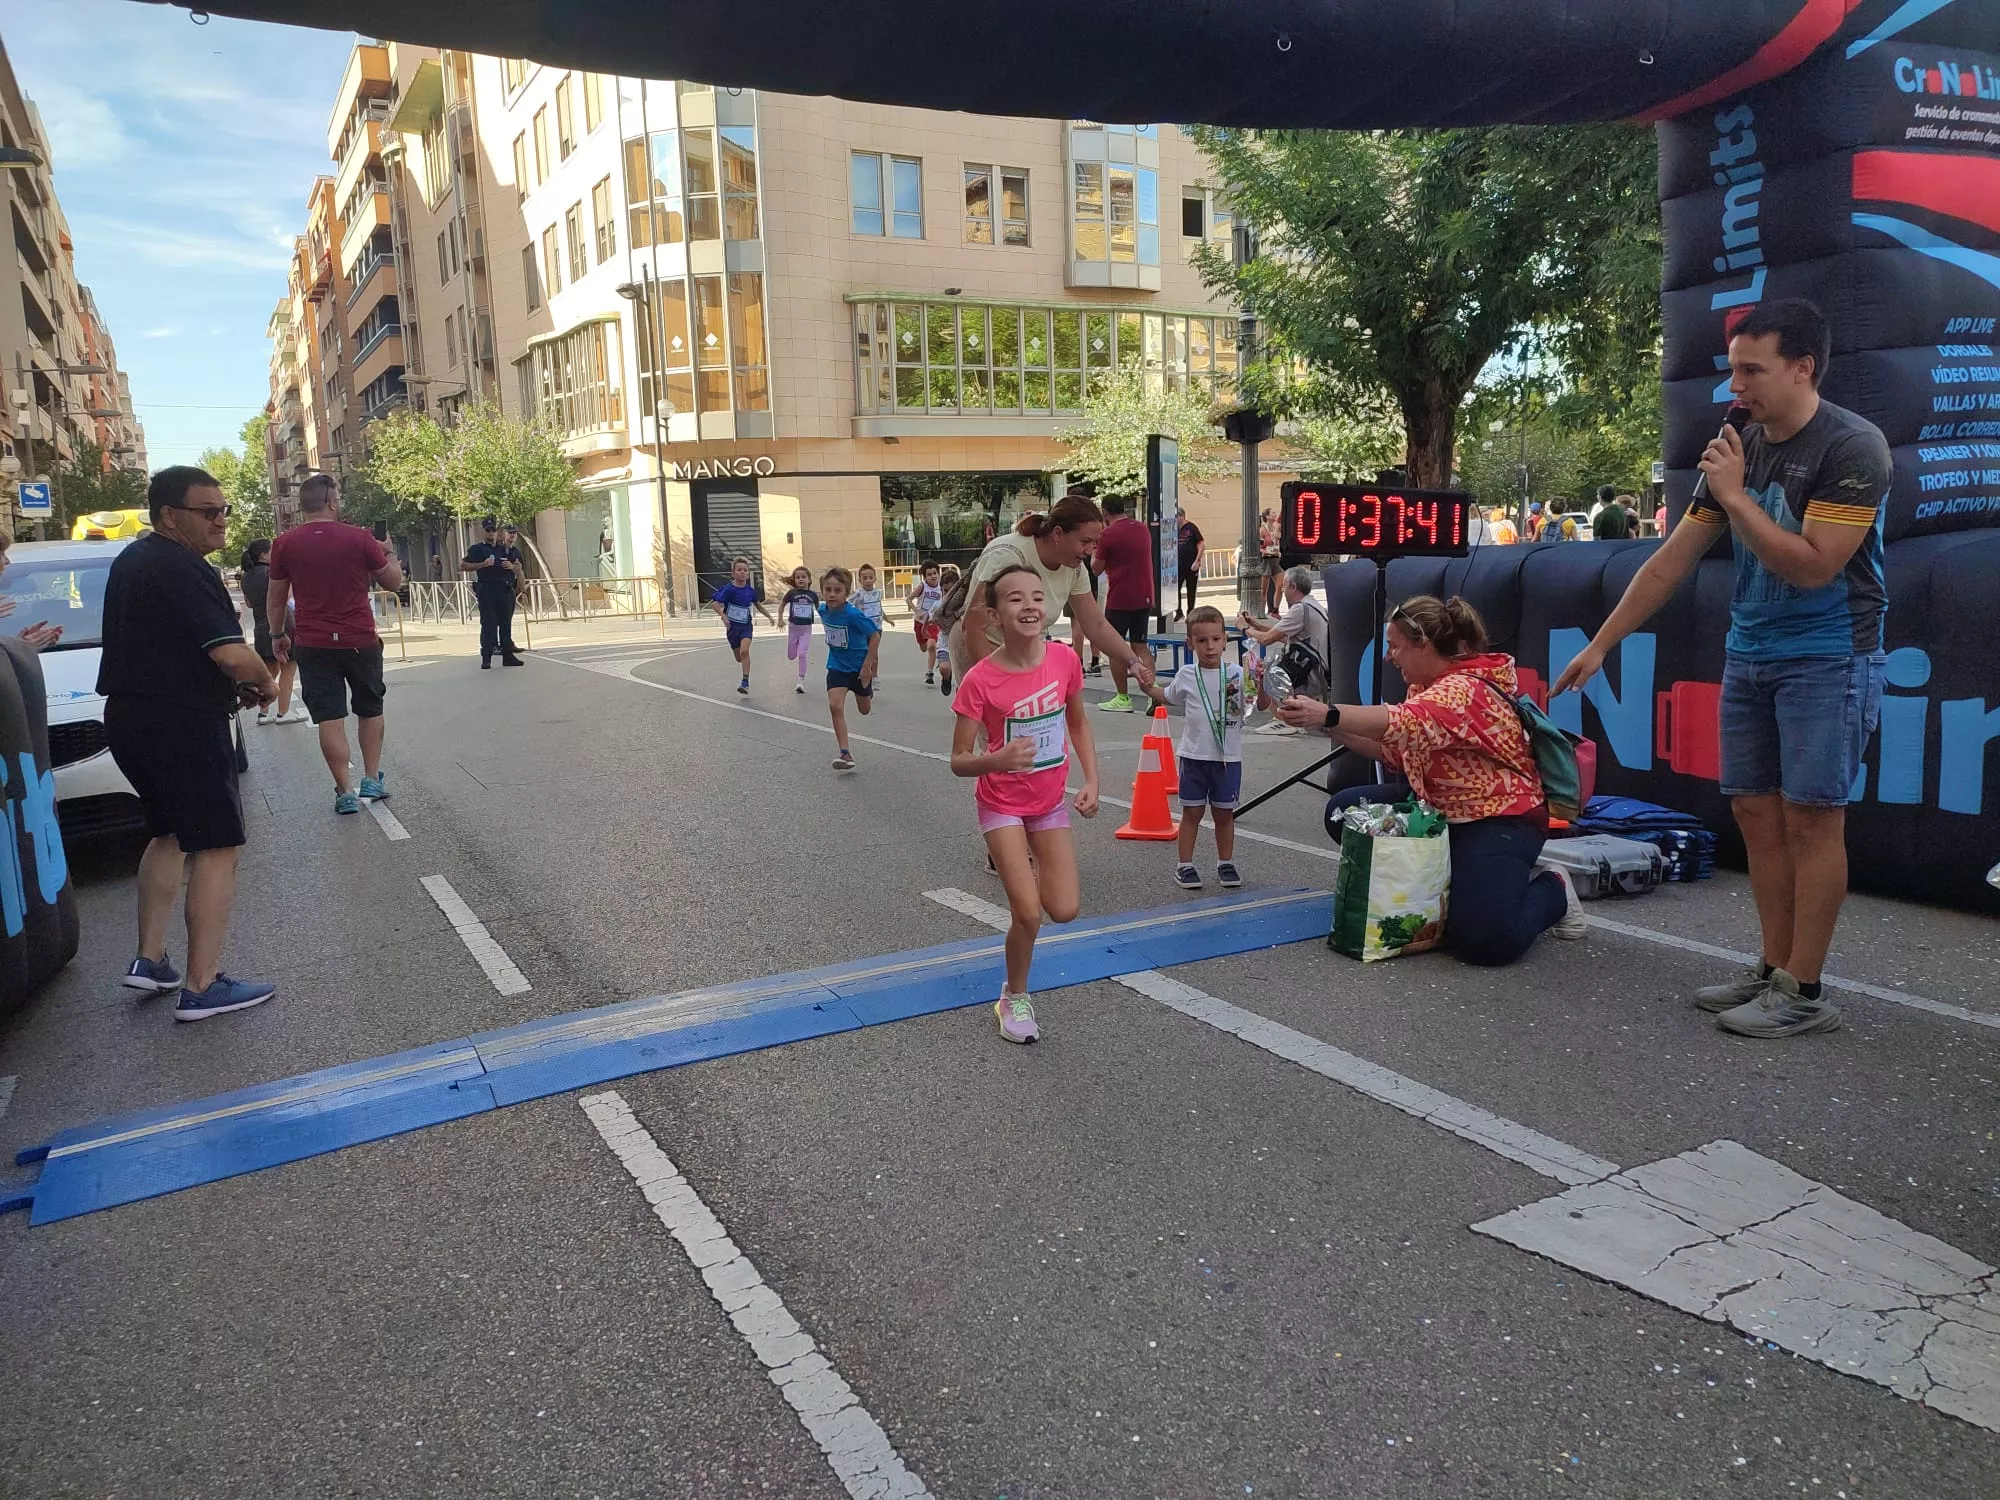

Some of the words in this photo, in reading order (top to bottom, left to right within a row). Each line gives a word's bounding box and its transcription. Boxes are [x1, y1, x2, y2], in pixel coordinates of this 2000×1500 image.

[1914, 103, 1948, 119] Servicio
[1949, 106, 1961, 120] de
[1905, 124, 1938, 140] gestión
[1938, 125, 1951, 140] de
[1950, 129, 1985, 142] eventos
[1943, 317, 1972, 334] APP
[1970, 317, 1997, 334] LIVE
[1930, 363, 1969, 384] VÍDEO
[1933, 393, 1977, 413] VALLAS
[1978, 393, 1987, 409] Y
[1917, 423, 1955, 441] BOLSA
[1918, 445, 1972, 463] SPEAKER
[1970, 444, 1981, 458] Y
[672, 456, 775, 480] MANGO
[1919, 470, 1970, 492] TROFEOS
[1971, 470, 1980, 486] Y
[1915, 500, 1945, 520] CHIP
[1943, 496, 1987, 514] ACTIVO
